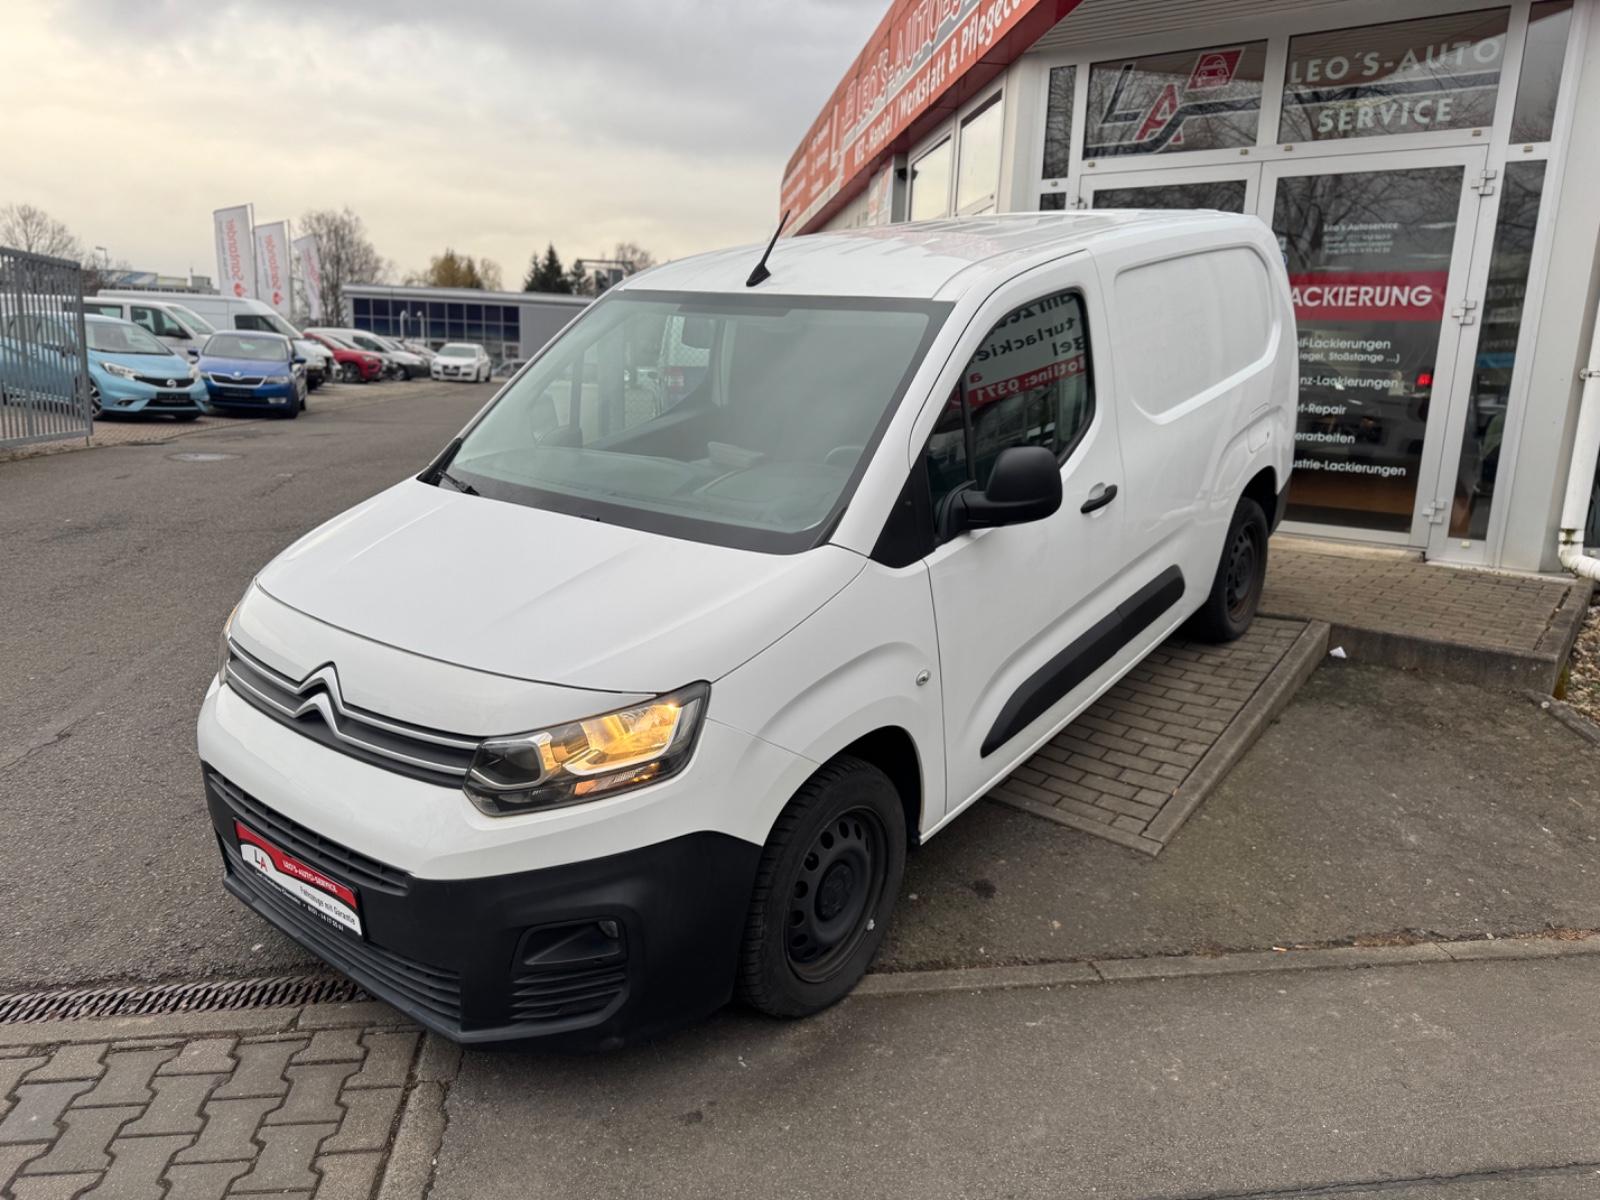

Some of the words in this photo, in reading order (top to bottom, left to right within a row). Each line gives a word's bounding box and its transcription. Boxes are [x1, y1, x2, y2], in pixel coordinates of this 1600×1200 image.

[900, 52, 946, 119] Werkstatt
[949, 37, 957, 75] &
[1317, 98, 1454, 134] SERVICE
